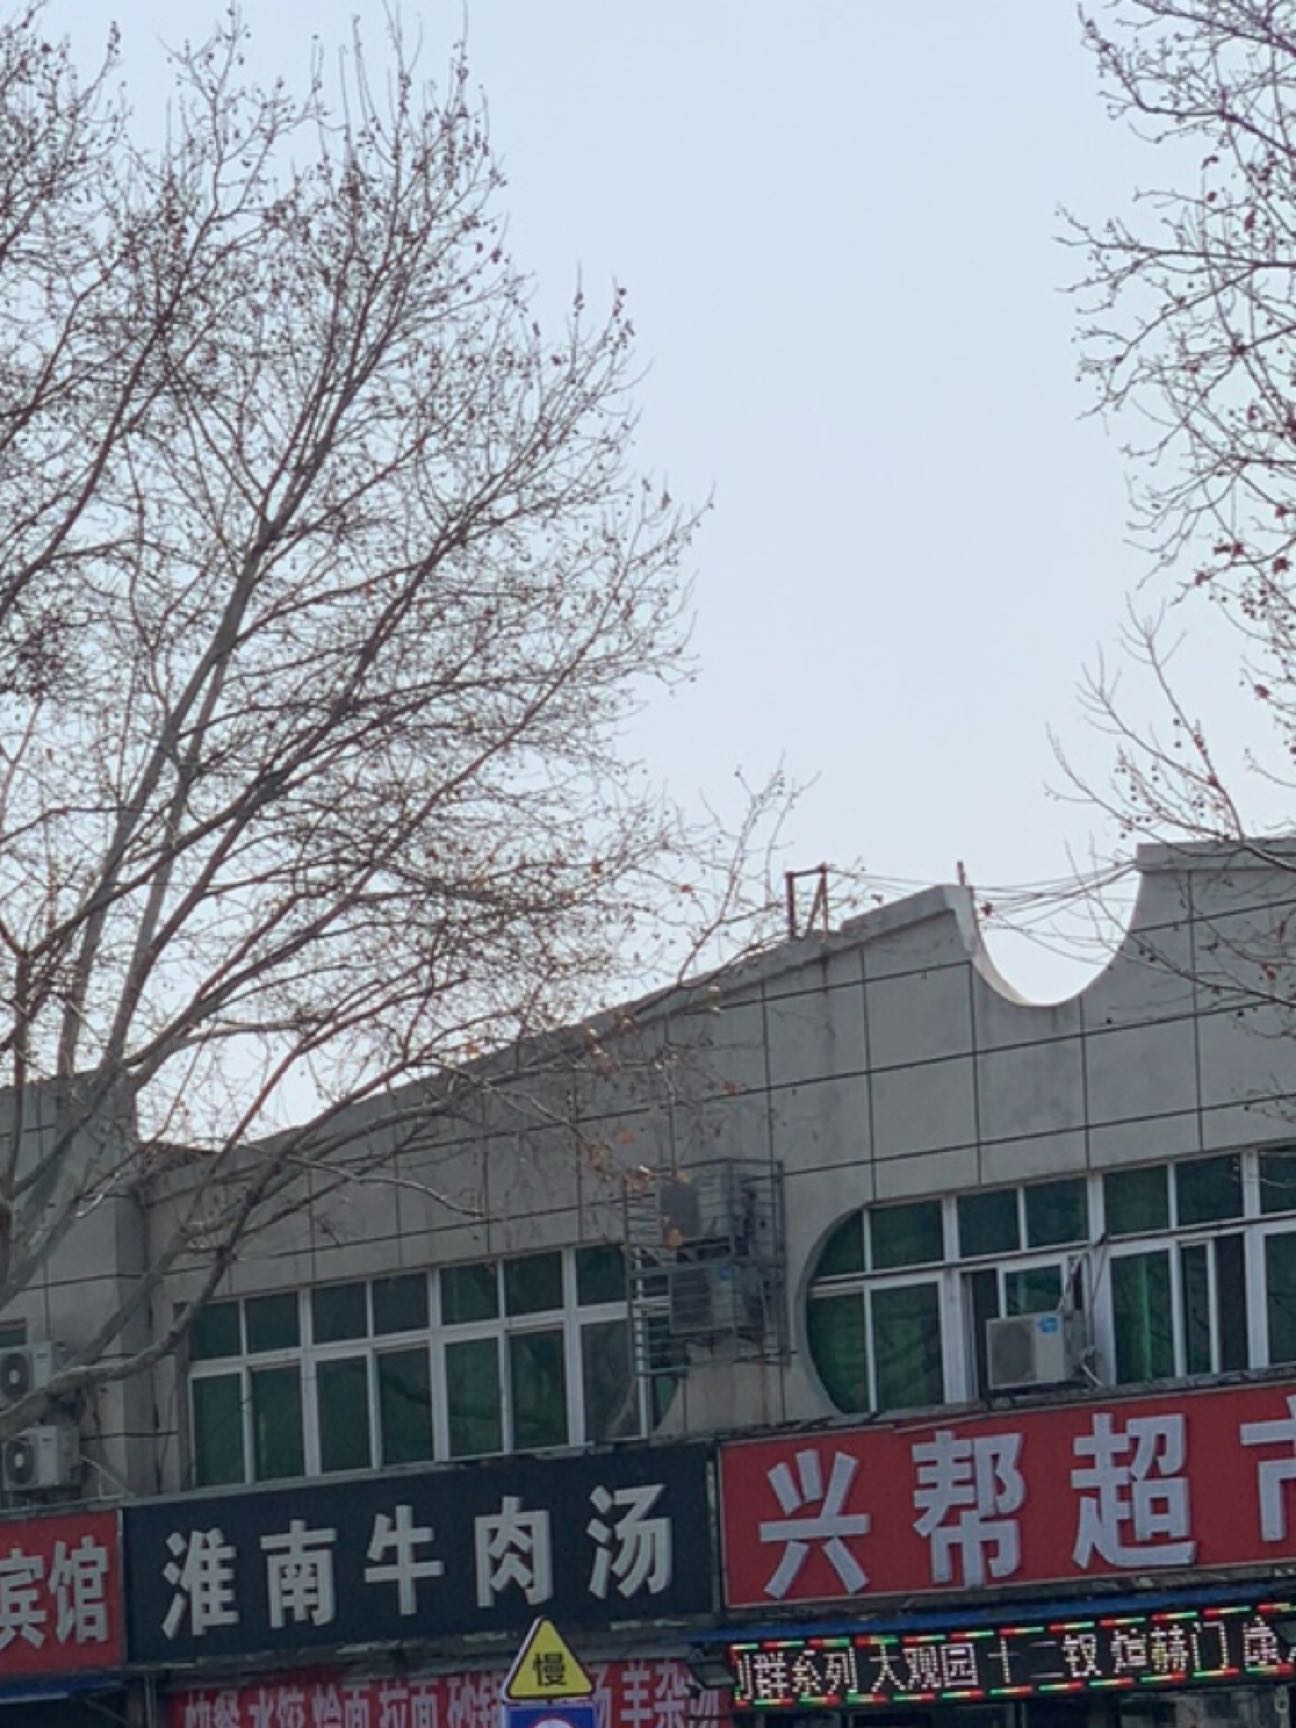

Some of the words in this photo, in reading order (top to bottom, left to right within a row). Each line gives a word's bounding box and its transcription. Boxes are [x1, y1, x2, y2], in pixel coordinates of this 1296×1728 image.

[160, 1483, 674, 1642] 淮南牛肉汤
[532, 1653, 568, 1687] 慢
